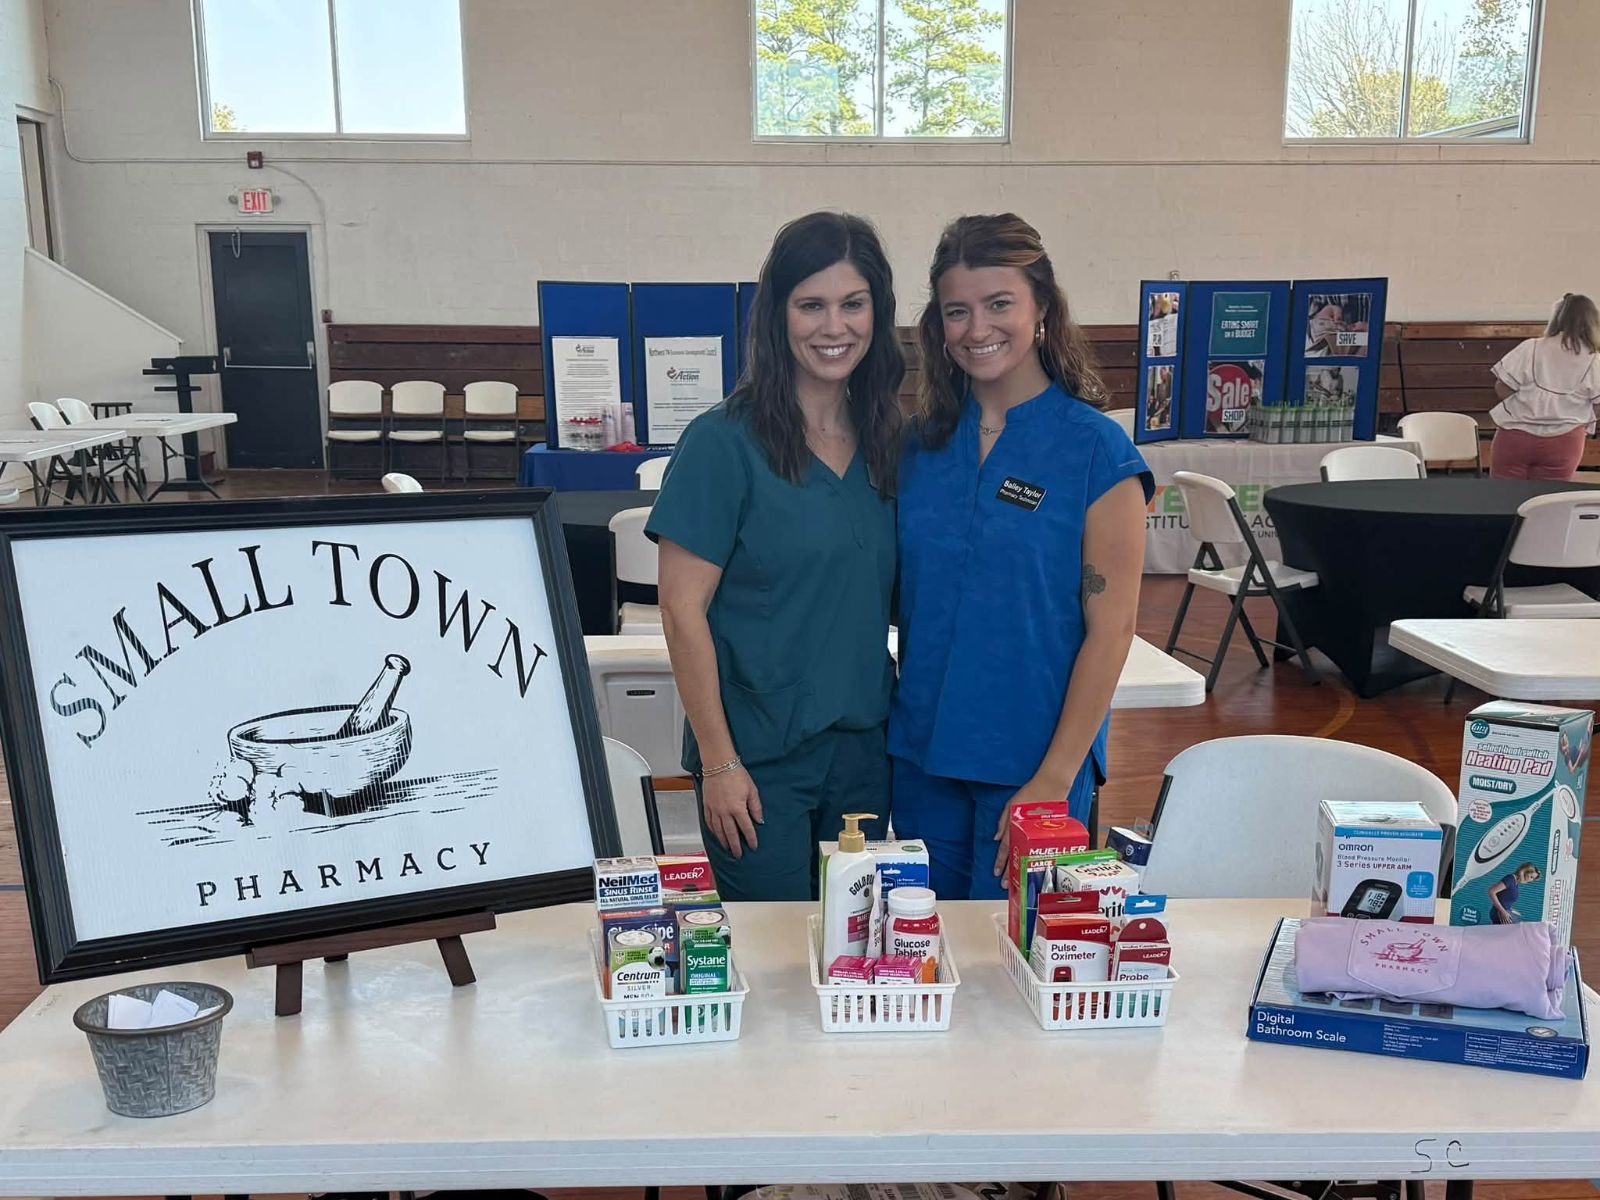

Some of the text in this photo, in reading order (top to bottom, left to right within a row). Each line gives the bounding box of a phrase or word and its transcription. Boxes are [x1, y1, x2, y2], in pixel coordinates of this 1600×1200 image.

[243, 191, 267, 211] EXIT
[1235, 330, 1256, 338] BUDGET
[1338, 333, 1357, 345] SAVE
[1208, 373, 1250, 412] Sale
[1223, 410, 1245, 422] SHOP
[1003, 479, 1042, 499] Bailey Taylor
[49, 540, 548, 750] SMALL TOWN
[1466, 750, 1553, 777] Heating Pad
[1472, 776, 1514, 792] MOIST/DRY
[1028, 845, 1087, 856] MUELLER
[1338, 843, 1374, 852] OMRON
[1030, 860, 1053, 868] LARGE
[1337, 860, 1342, 868] 3
[1344, 861, 1371, 869] Series
[196, 841, 494, 908] PHARMACY
[599, 873, 658, 888] NeilMed
[664, 871, 699, 881] LEADER
[604, 886, 653, 897] SINUS RINSE
[849, 875, 866, 896] GOLD
[1081, 928, 1104, 936] LEADER
[894, 938, 931, 949] Glucose
[1360, 926, 1449, 953] SMALL TOWN
[894, 948, 927, 958] Tablets
[1051, 943, 1077, 953] Pulse
[687, 954, 726, 971] Systane
[1051, 952, 1097, 962] Oximeter
[1375, 962, 1430, 974] PHARMACY
[617, 971, 661, 982] Centrum
[1120, 973, 1149, 981] Probe
[627, 984, 651, 992] SILVER
[1257, 1011, 1295, 1026] Digital
[1256, 1023, 1347, 1043] Bathroom Scale
